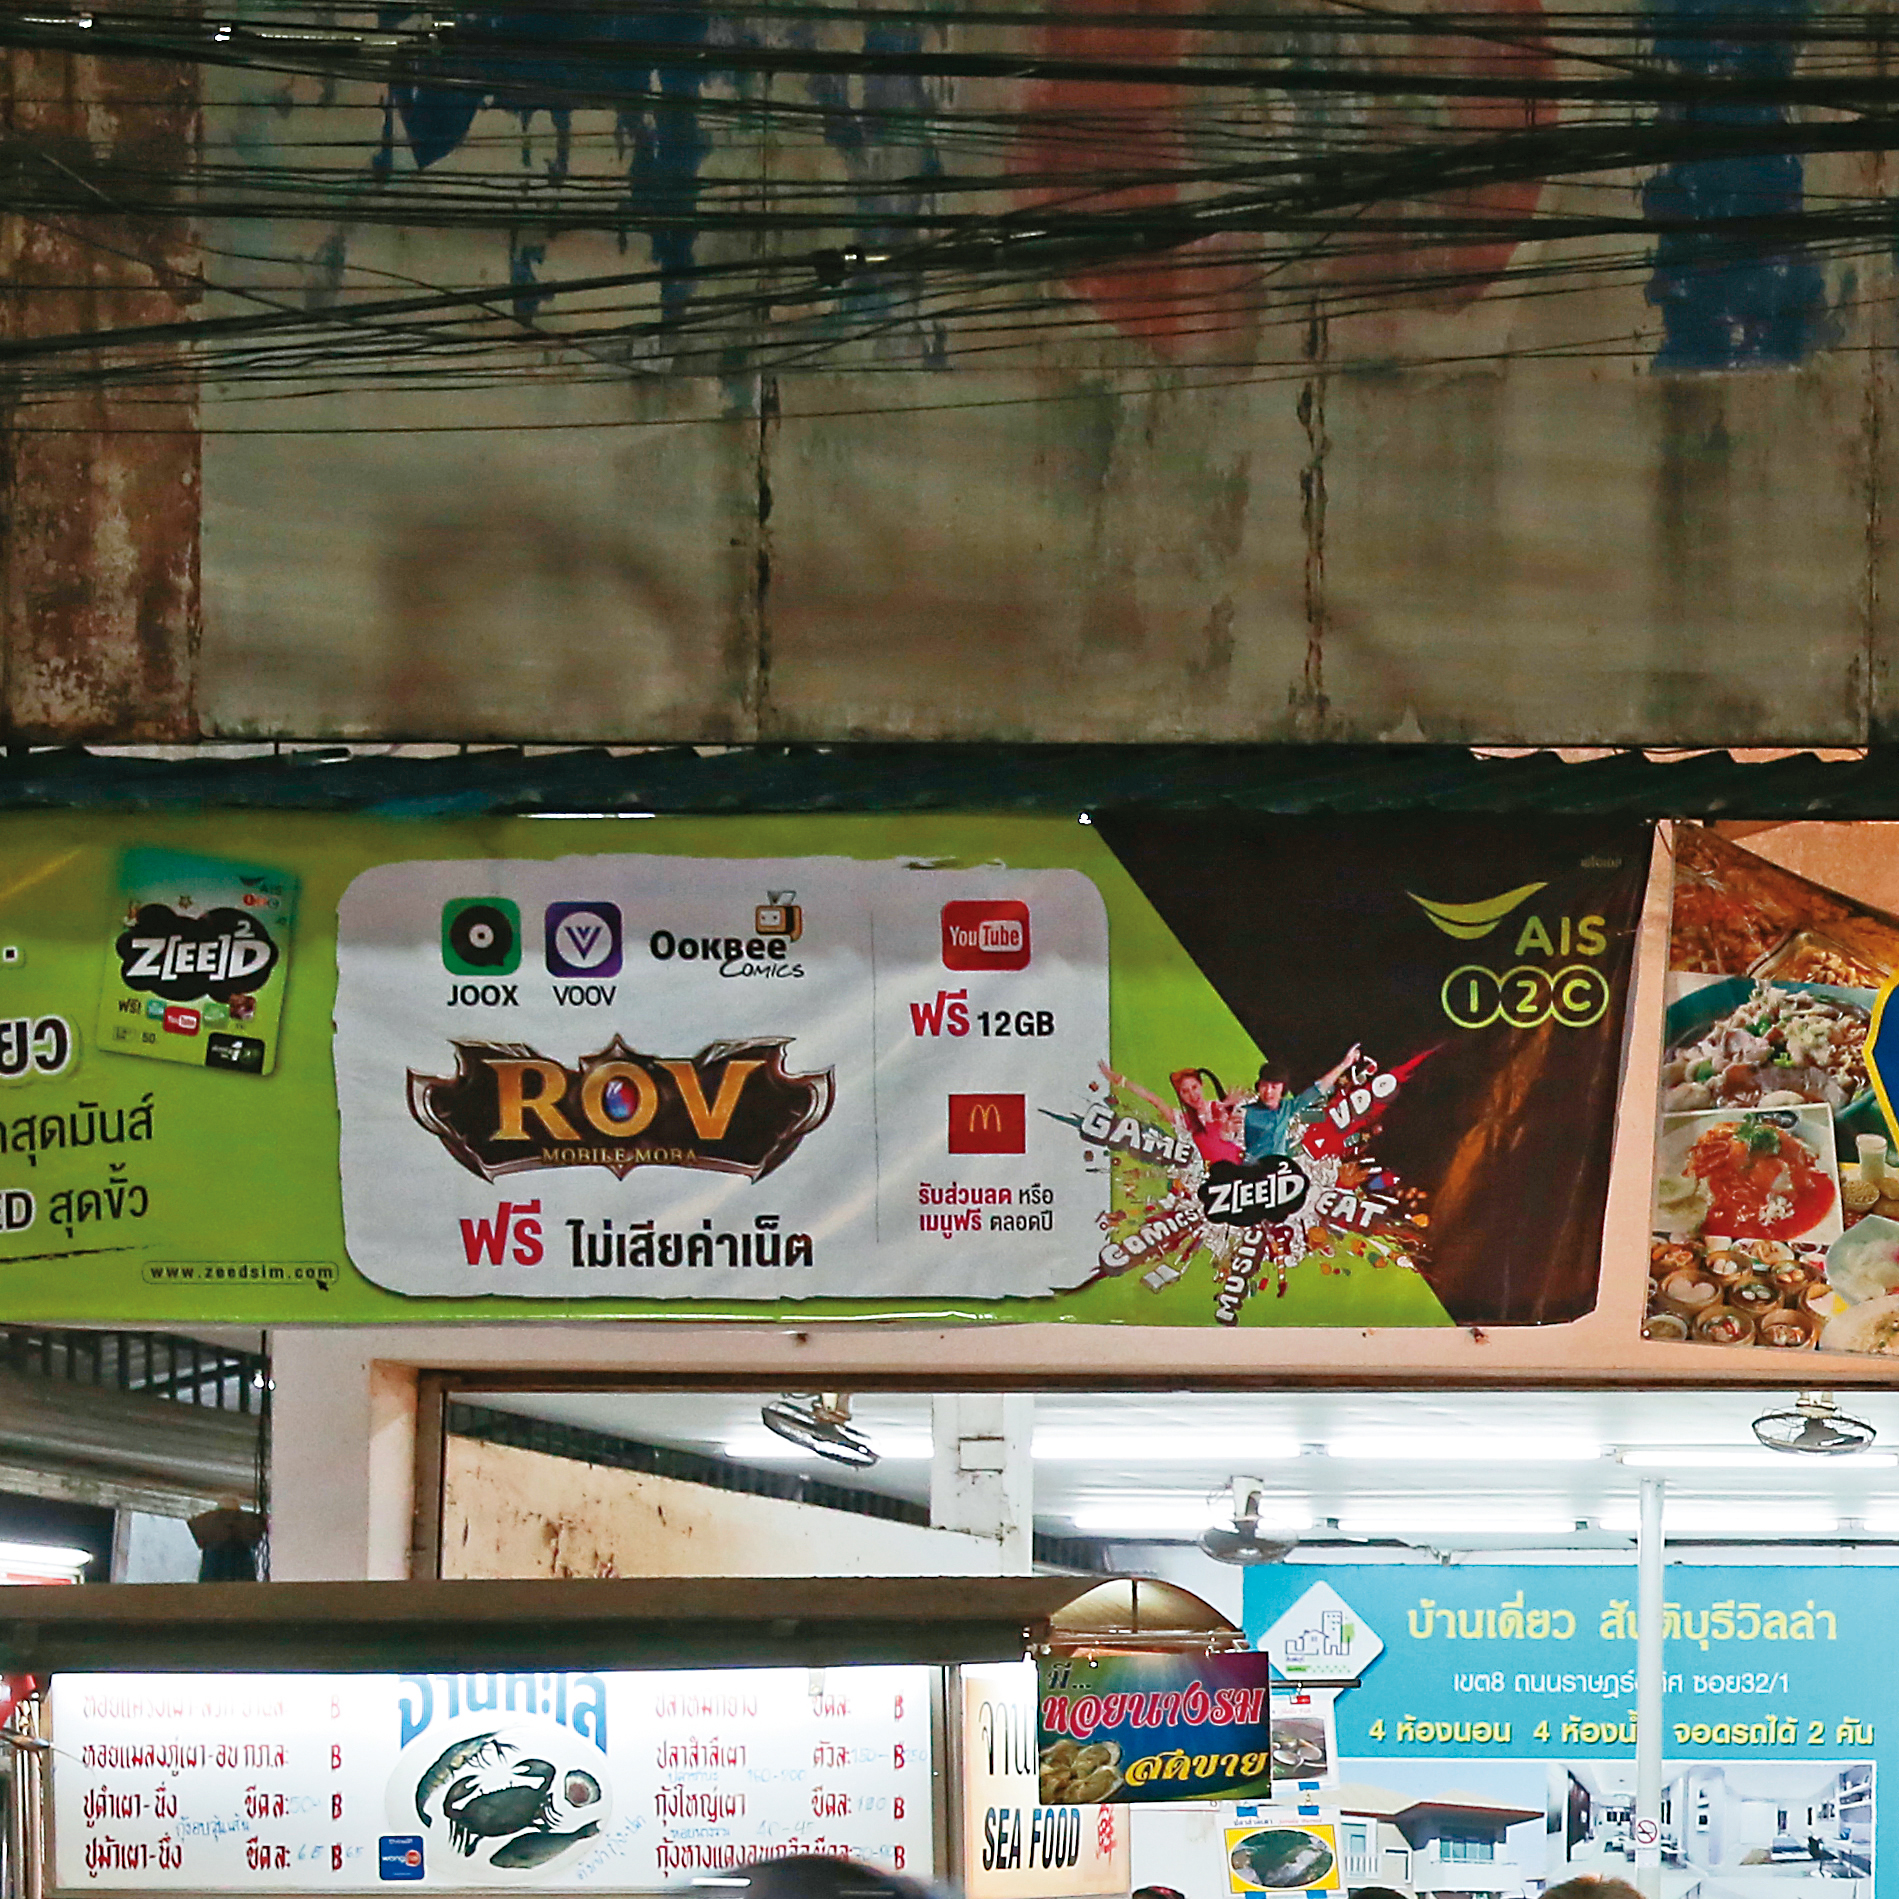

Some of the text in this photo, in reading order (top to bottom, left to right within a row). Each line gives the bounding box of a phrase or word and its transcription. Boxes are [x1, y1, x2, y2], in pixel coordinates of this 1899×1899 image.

[1515, 915, 1607, 956] AIS
[447, 985, 519, 1006] JOOX
[553, 985, 617, 1006] VOOV
[910, 988, 1055, 1037] ฟรี 12GB
[483, 1057, 768, 1140] ROV
[1329, 1073, 1398, 1130] VDO
[1080, 1103, 1192, 1164] GAME
[542, 1147, 699, 1164] MOBILE MOBA
[919, 1182, 1054, 1205] รับส่วนลด หรือ
[1317, 1190, 1387, 1228] EAT
[460, 1199, 813, 1268] ฟรี ไม่เสียค่าเน็ต
[919, 1208, 1054, 1239] เมนูฟรี ตลอดปี
[150, 1263, 334, 1283] www.zeedsim.com
[1216, 1228, 1264, 1322] MUSIC
[1407, 1590, 1576, 1640] บ้านเดี่ยว
[1454, 1671, 1790, 1694] เขต8 ซอย32/1
[1042, 1680, 1265, 1739] หอยนางรม
[1368, 1712, 1874, 1746] 4 ห้องนอน 4 จอดรถได้ 2 คัน
[982, 1807, 1021, 1871] SEA
[1029, 1807, 1080, 1869] FOOD
